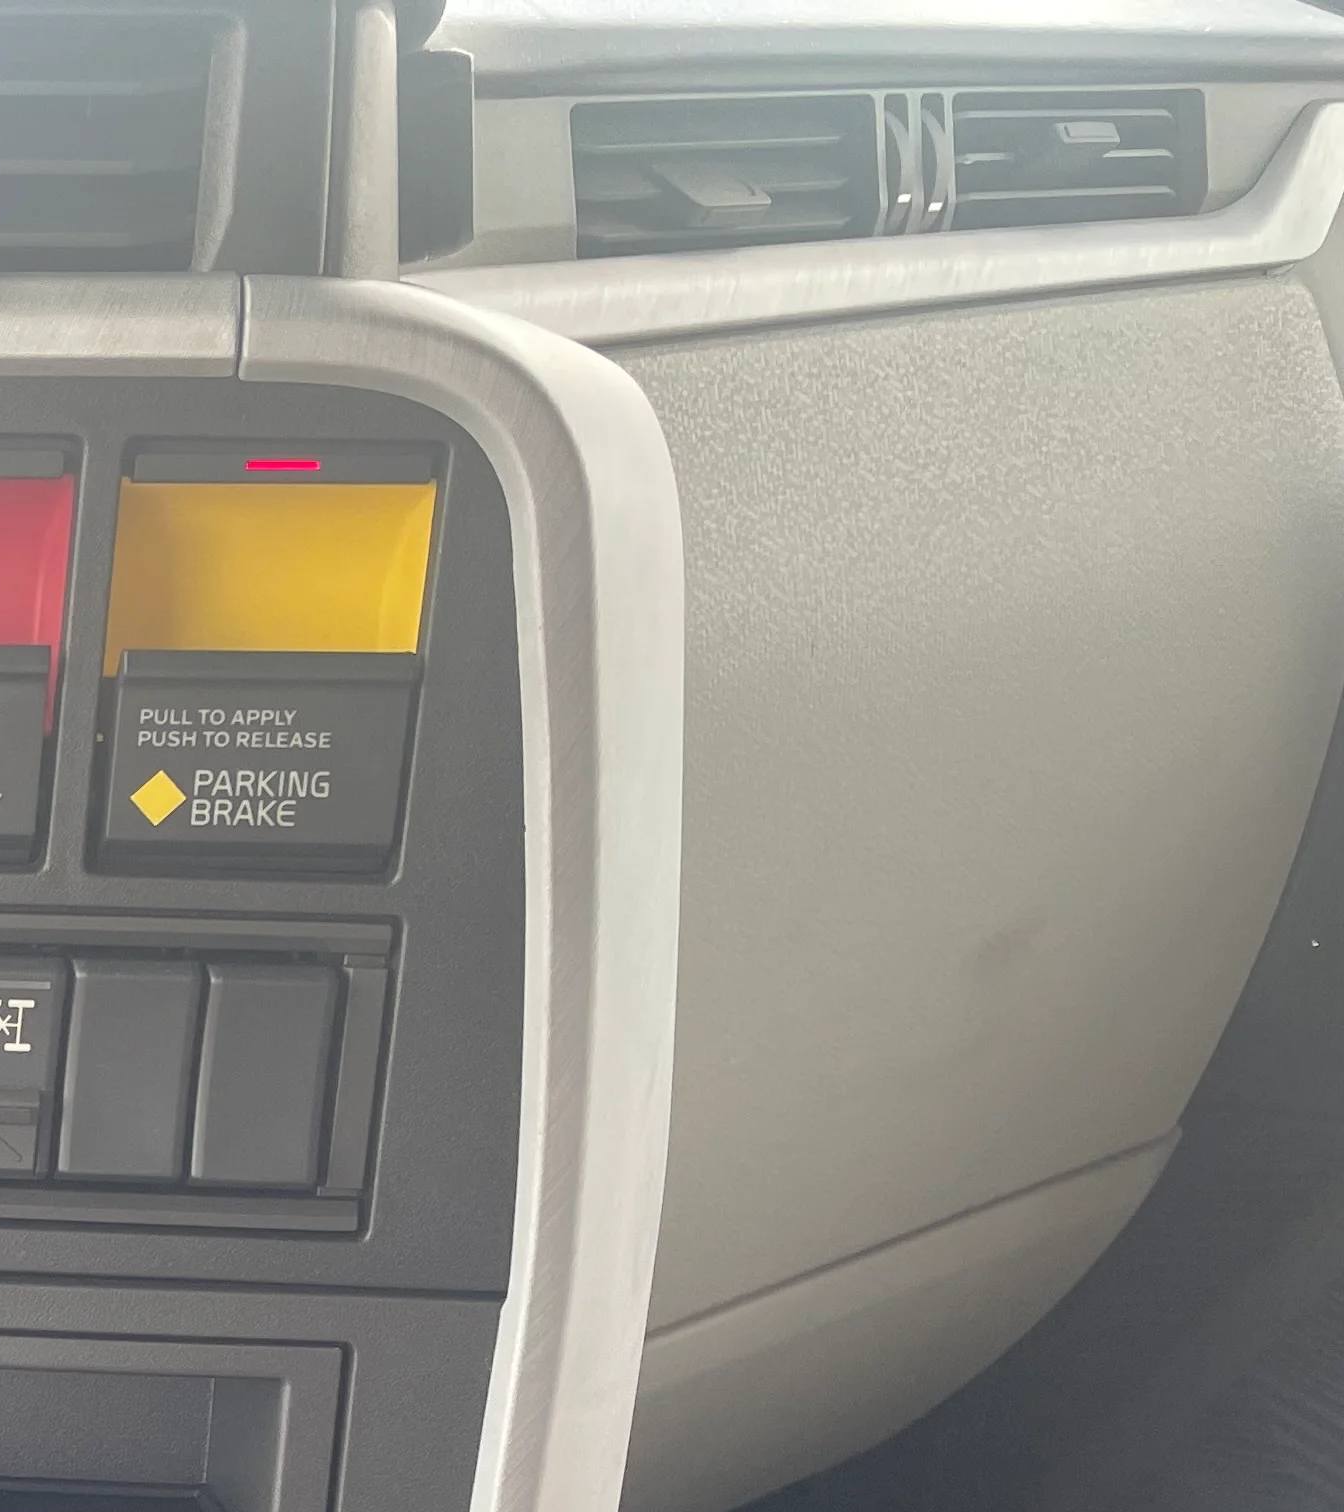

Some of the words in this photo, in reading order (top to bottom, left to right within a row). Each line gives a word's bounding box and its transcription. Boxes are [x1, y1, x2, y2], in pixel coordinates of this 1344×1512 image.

[139, 708, 193, 725] PULL
[198, 708, 226, 726] TO
[230, 709, 297, 726] APPLY
[137, 730, 197, 747] PUSH
[202, 731, 230, 748] TO
[235, 731, 332, 749] RELEASE
[192, 769, 330, 799] PARKING
[190, 800, 297, 828] BRAKE
